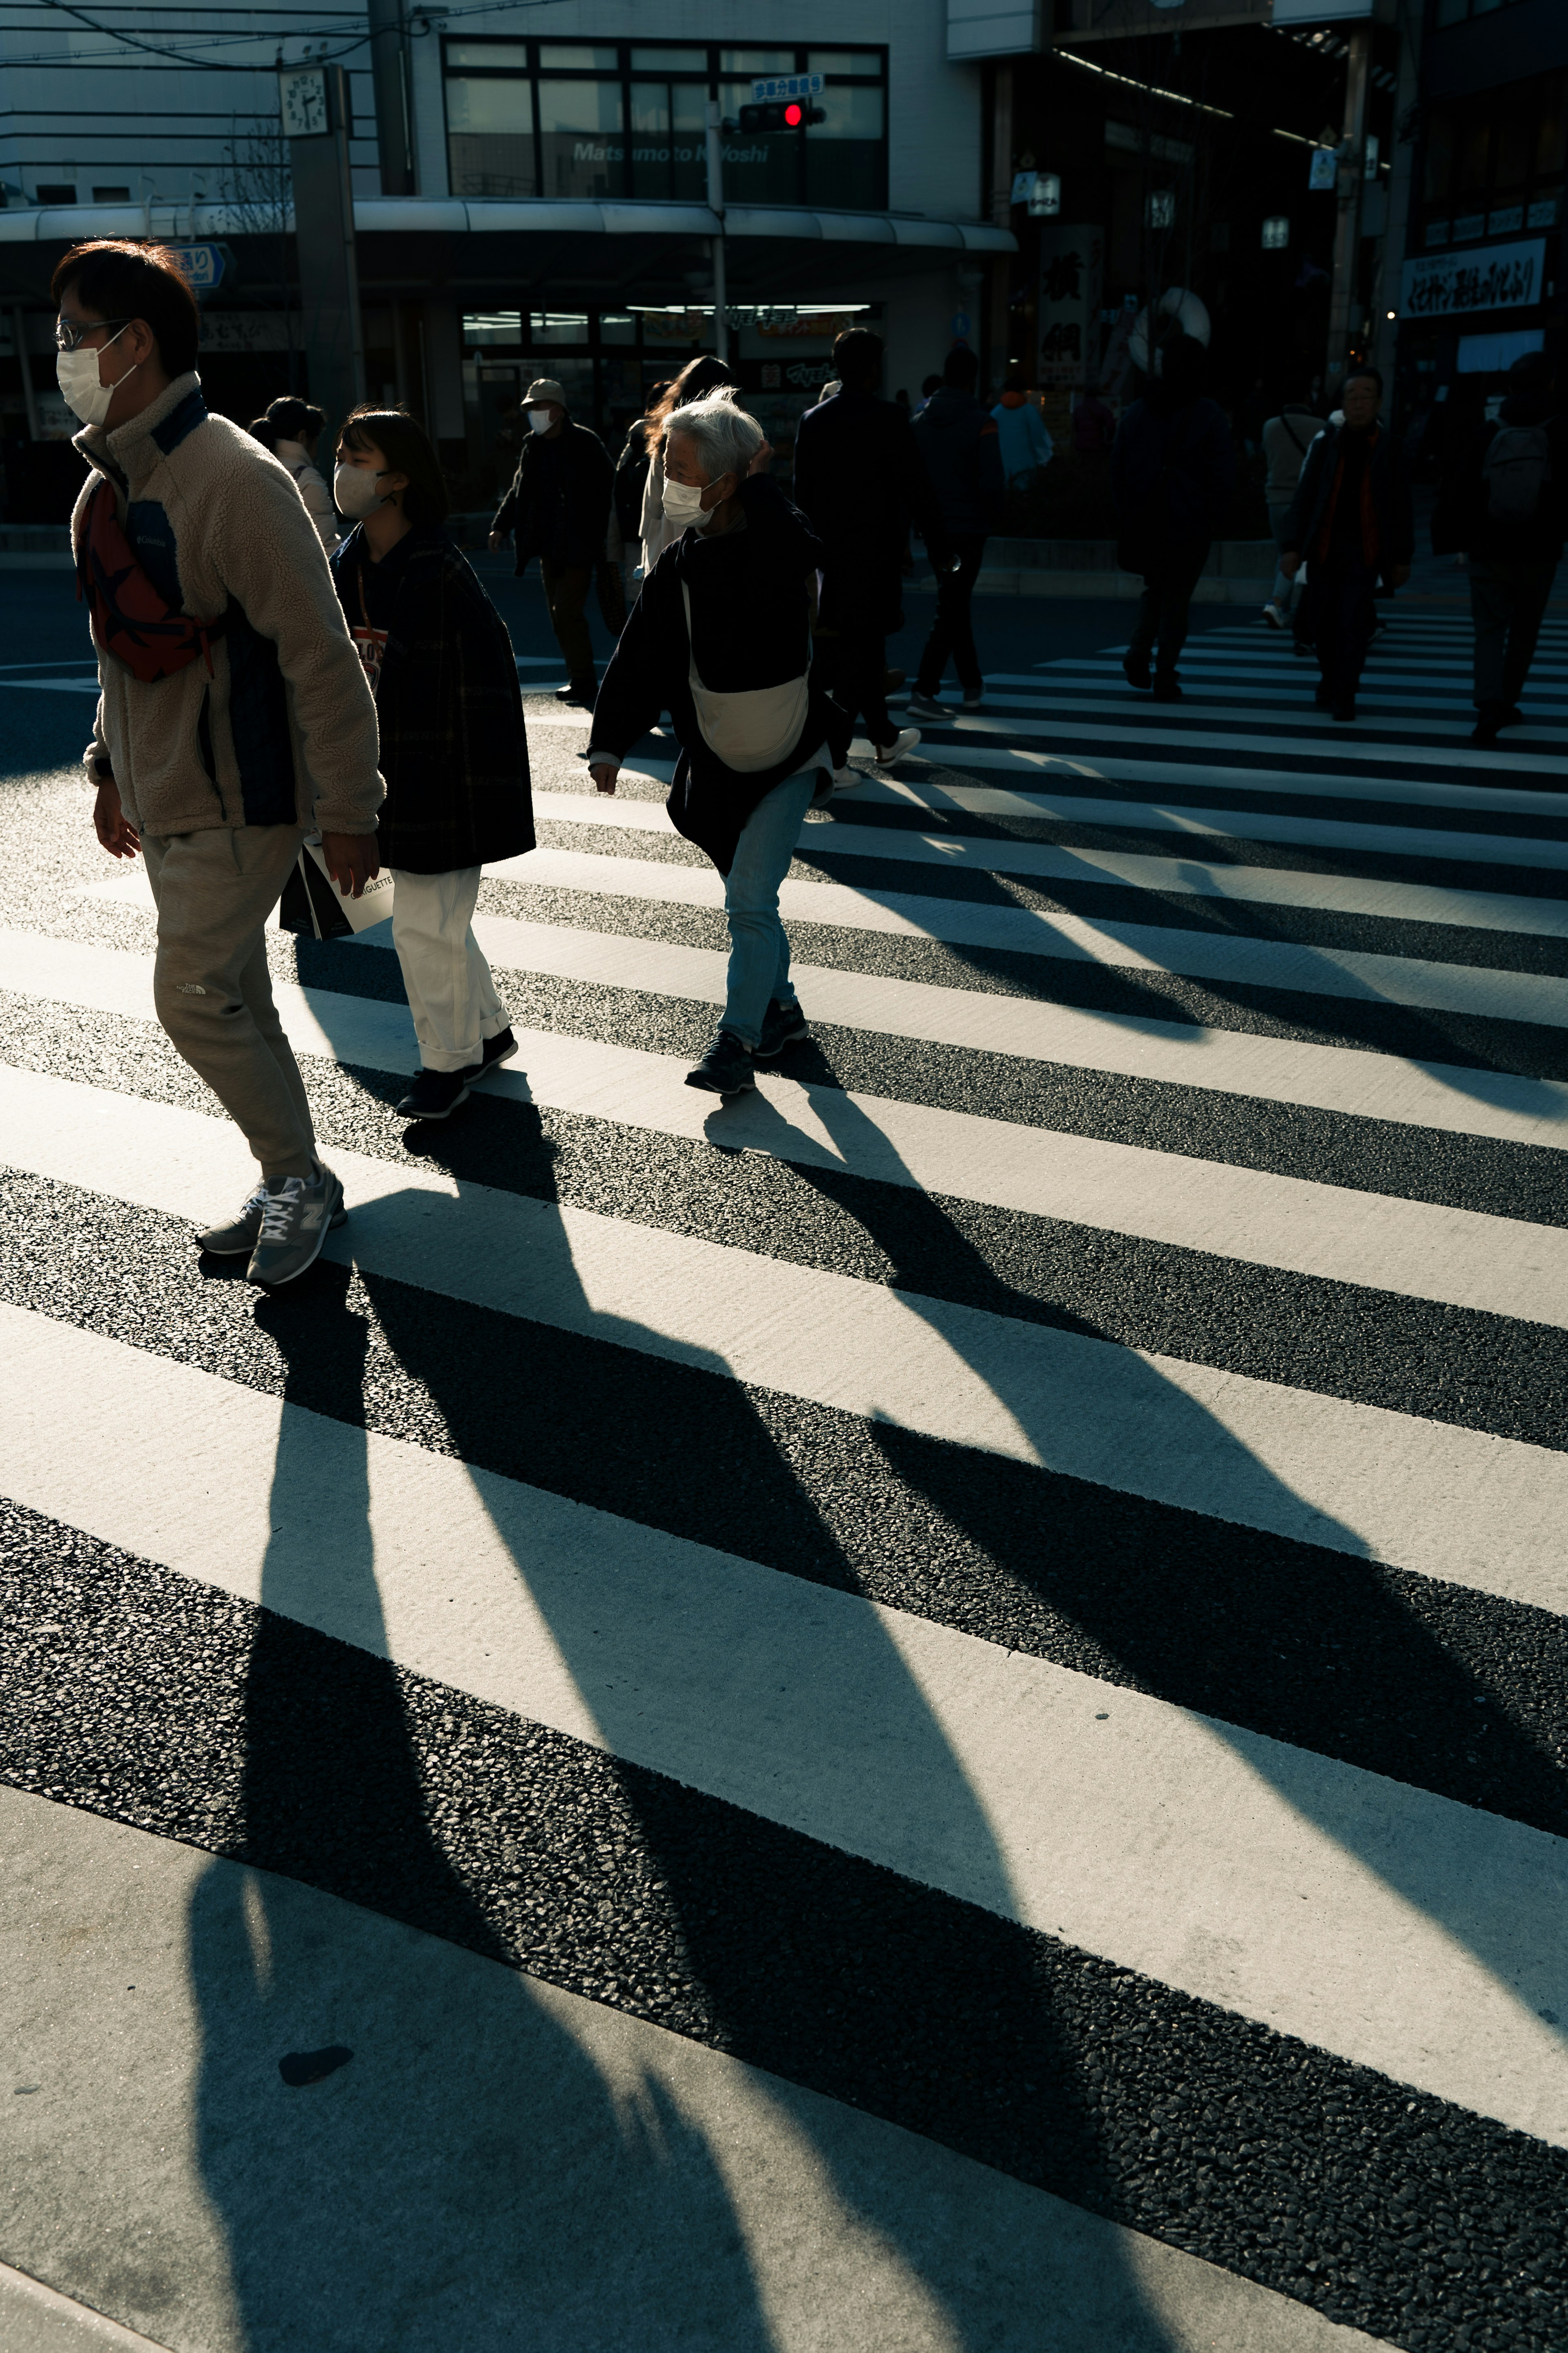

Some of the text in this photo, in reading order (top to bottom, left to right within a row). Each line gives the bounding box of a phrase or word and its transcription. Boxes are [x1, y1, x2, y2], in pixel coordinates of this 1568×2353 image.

[300, 76, 308, 85] 12
[310, 78, 314, 87] 1
[288, 89, 297, 98] 10
[315, 85, 321, 94] 2
[287, 100, 293, 109] 9
[318, 96, 324, 105] 3
[290, 110, 296, 120] 8
[316, 107, 322, 116] 4
[297, 118, 303, 127] 7
[312, 116, 318, 125] 5
[695, 144, 769, 163] KYoshi
[1042, 251, 1085, 361] 横綱
[726, 307, 798, 330] ツモトキヨシ
[786, 362, 839, 388] マツモト
[141, 535, 166, 547] Columbia
[351, 876, 392, 900] GIGUETTE
[300, 1203, 325, 1230] N
